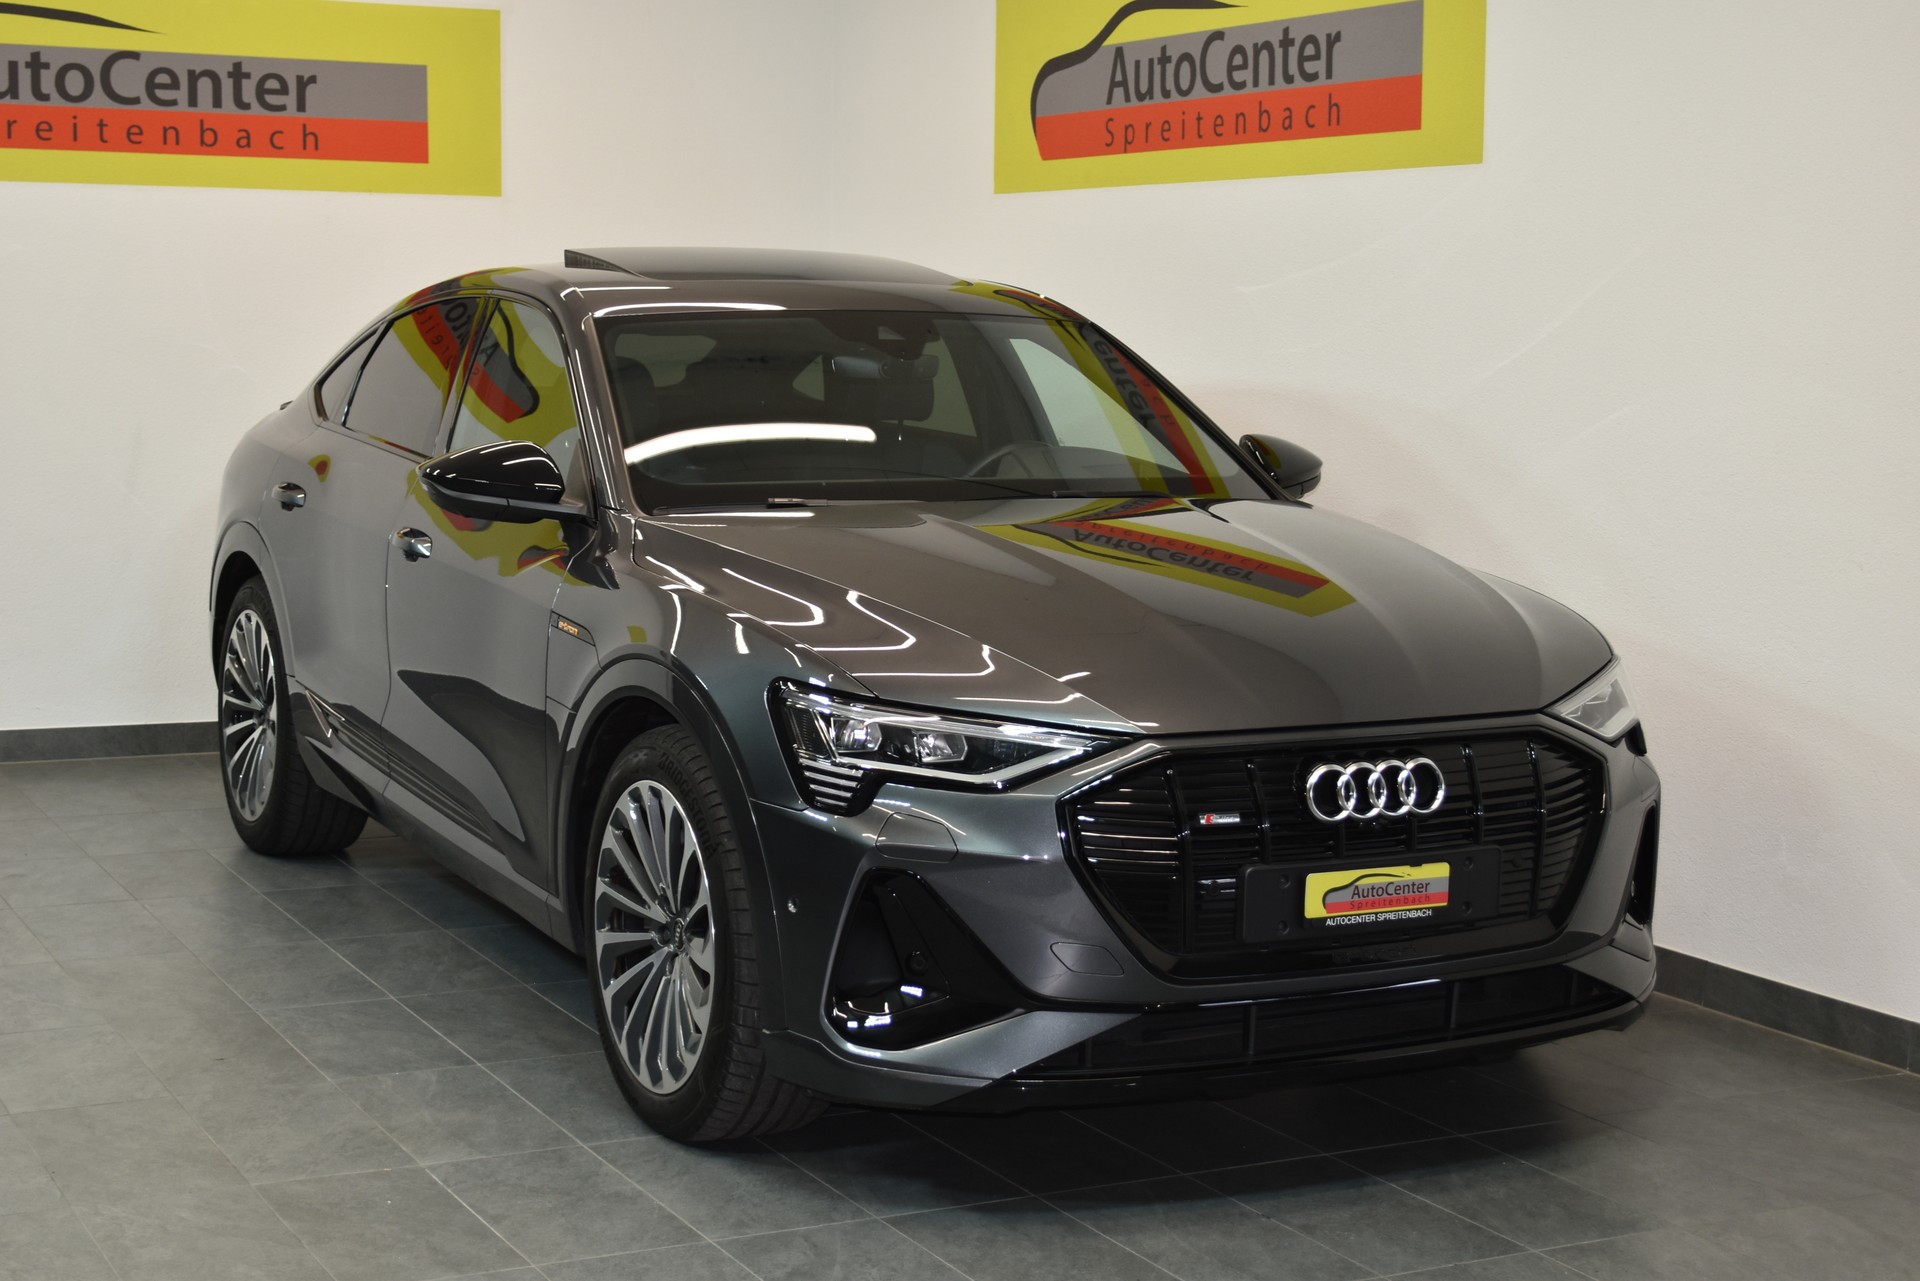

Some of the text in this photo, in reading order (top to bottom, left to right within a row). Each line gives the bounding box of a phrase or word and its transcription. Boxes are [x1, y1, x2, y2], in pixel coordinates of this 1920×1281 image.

[1105, 26, 1341, 106] AutoCenter
[1104, 93, 1341, 153] Spreitenbach
[1351, 881, 1430, 900] AutoCenter
[1349, 895, 1430, 911] Spreitenbach
[1325, 909, 1432, 926] AUTOCENTER SPREITENBACH
